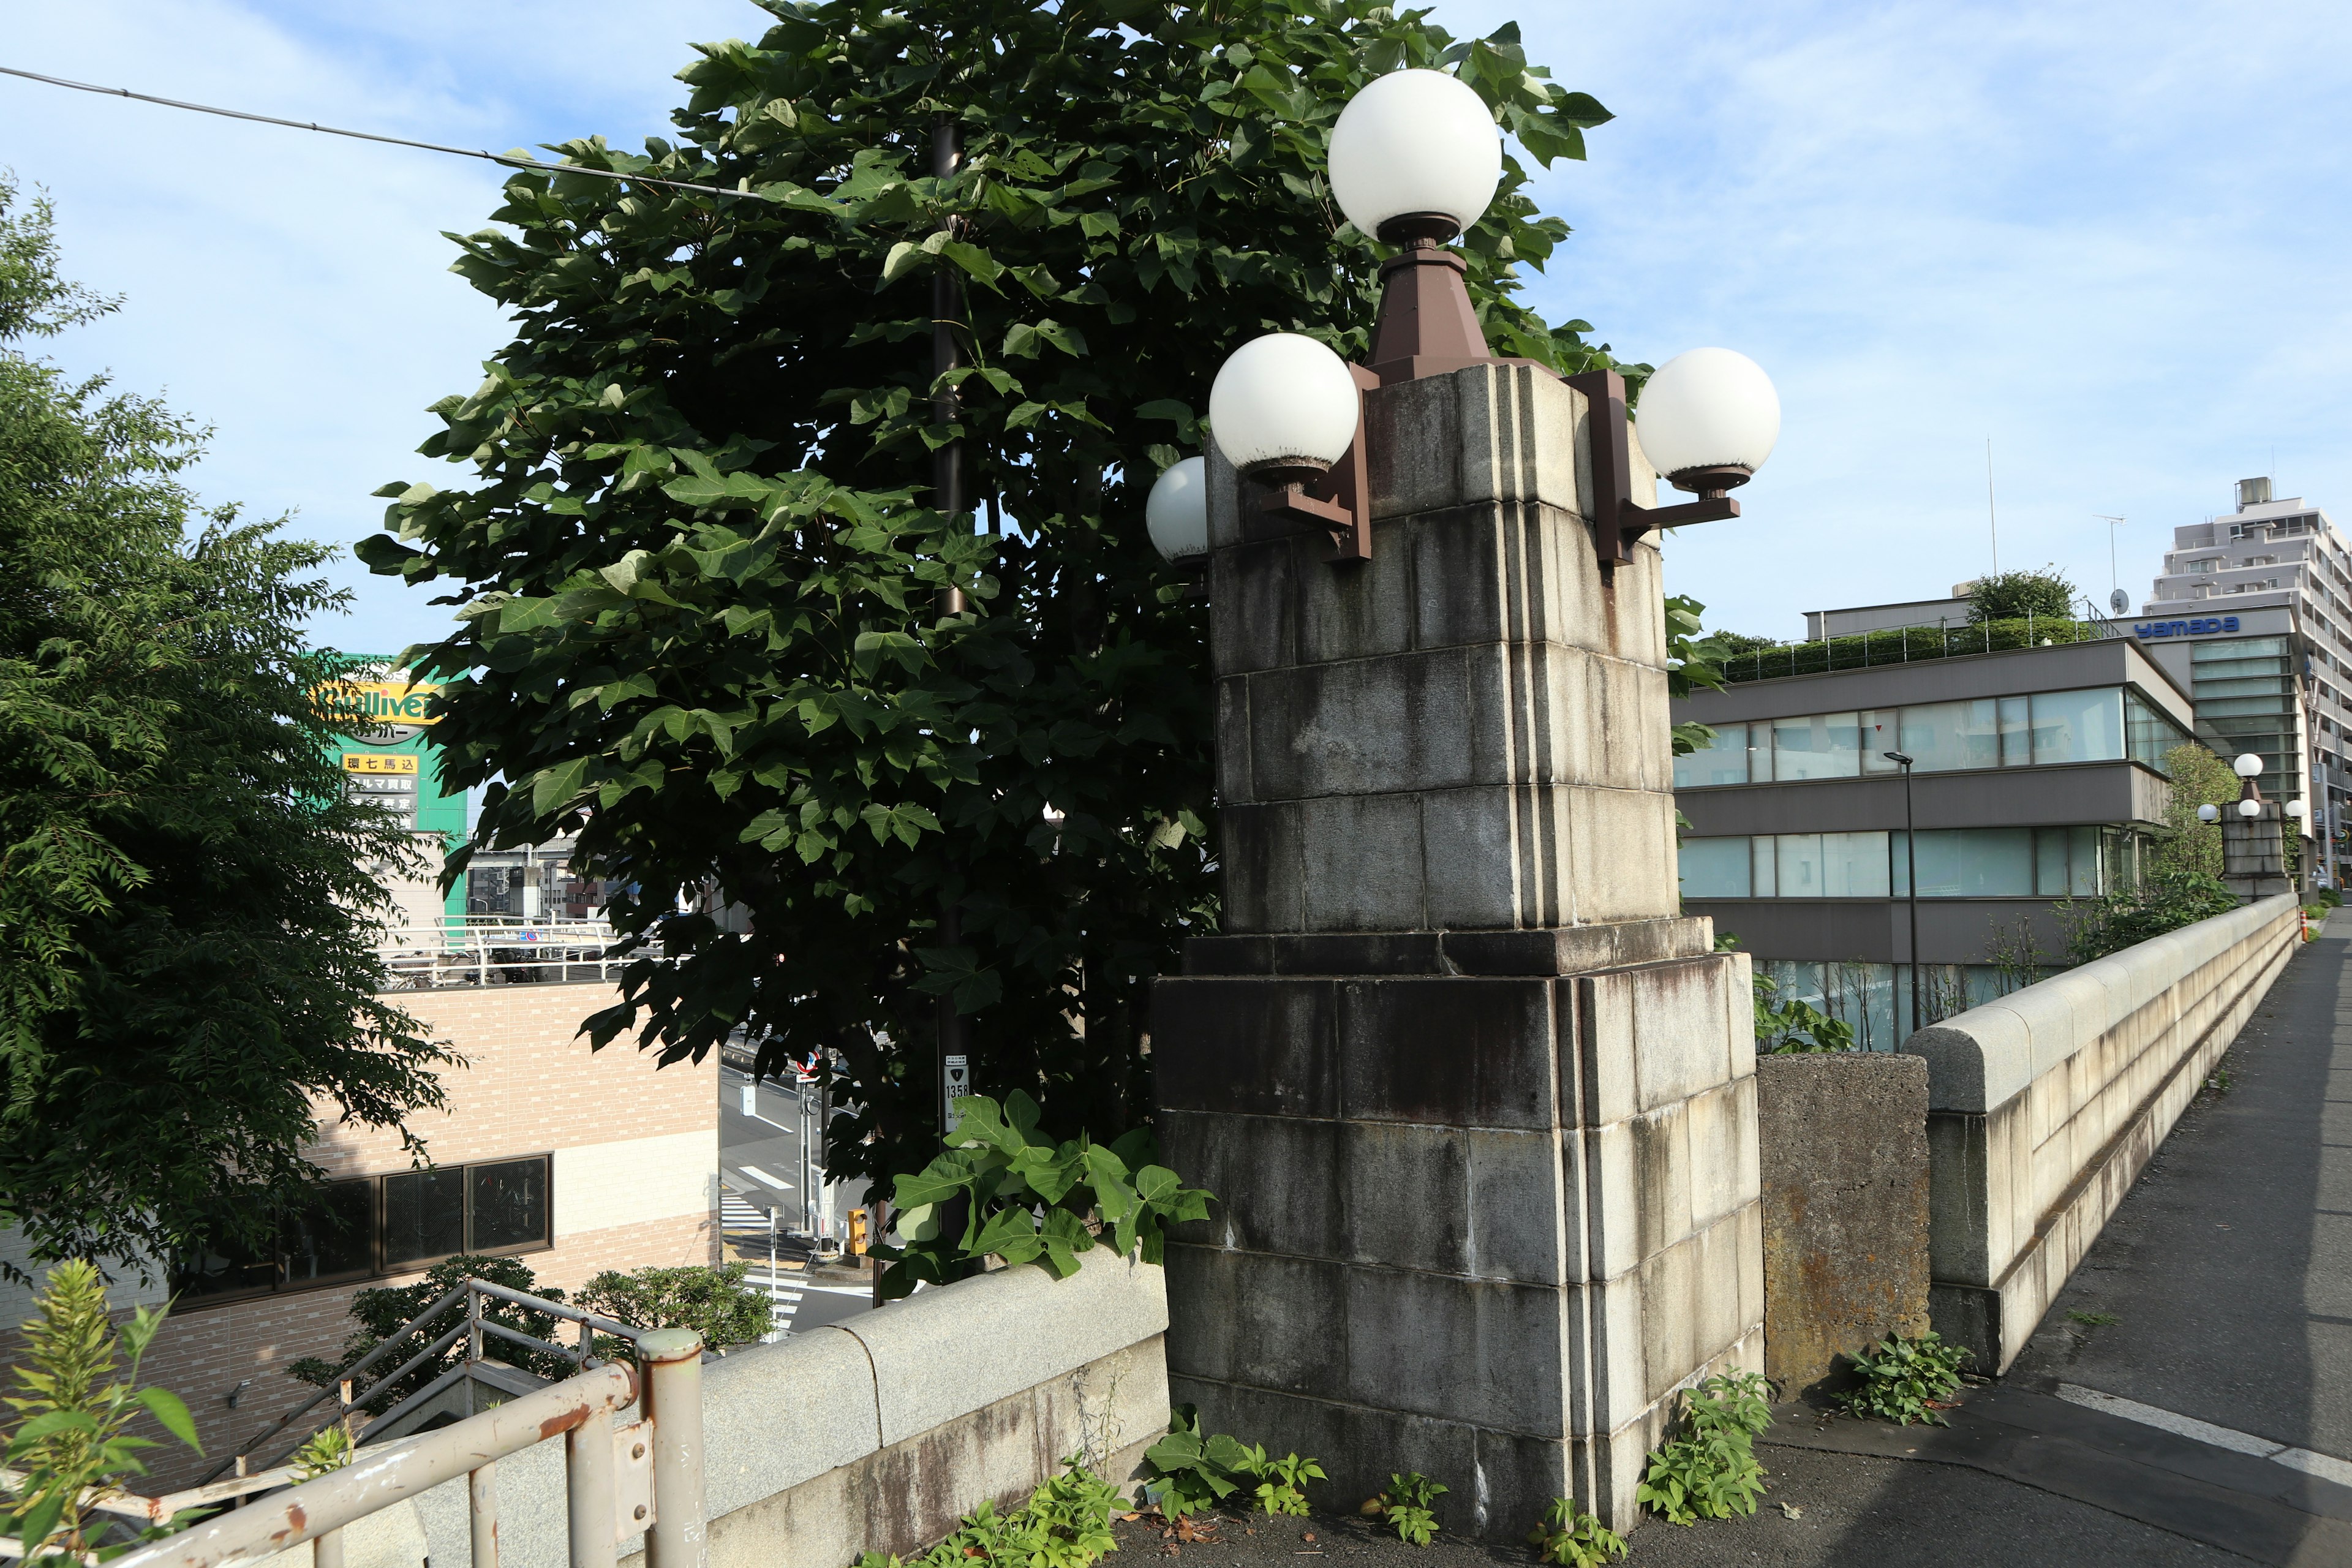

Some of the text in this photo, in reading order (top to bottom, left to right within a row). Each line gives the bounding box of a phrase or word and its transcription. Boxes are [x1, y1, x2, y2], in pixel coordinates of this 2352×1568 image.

[347, 758, 413, 771] 環七馬込
[946, 1085, 968, 1098] 1358
